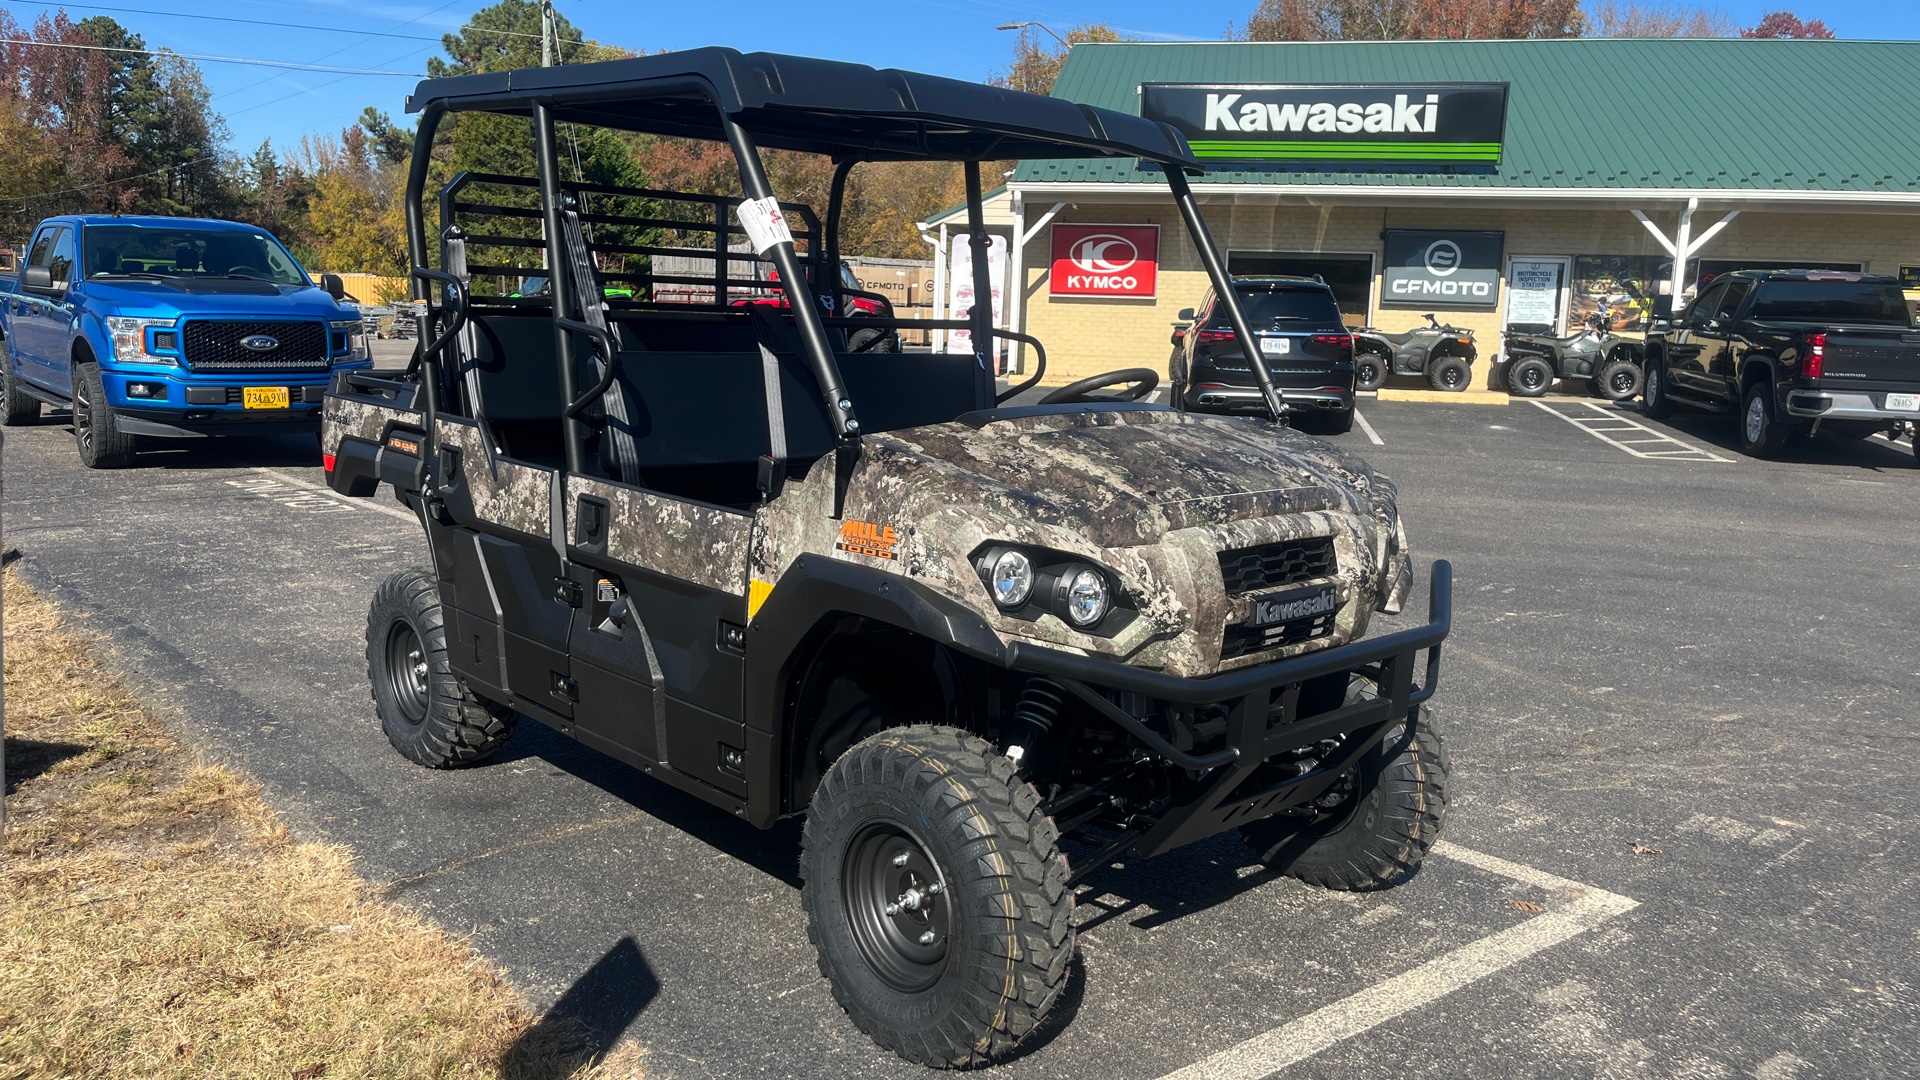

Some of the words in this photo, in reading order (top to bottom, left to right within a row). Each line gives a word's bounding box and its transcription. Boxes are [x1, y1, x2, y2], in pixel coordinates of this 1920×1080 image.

[1204, 93, 1439, 133] Kawasaki
[866, 281, 905, 290] CFMOTO
[1067, 275, 1138, 290] KYMCO
[1391, 278, 1490, 296] CFMOTO
[252, 339, 271, 347] Ford
[839, 519, 898, 544] MULE
[843, 535, 867, 546] PRO
[870, 541, 892, 550] FXT
[841, 543, 892, 560] 1000
[1256, 588, 1335, 625] Kawasaki
